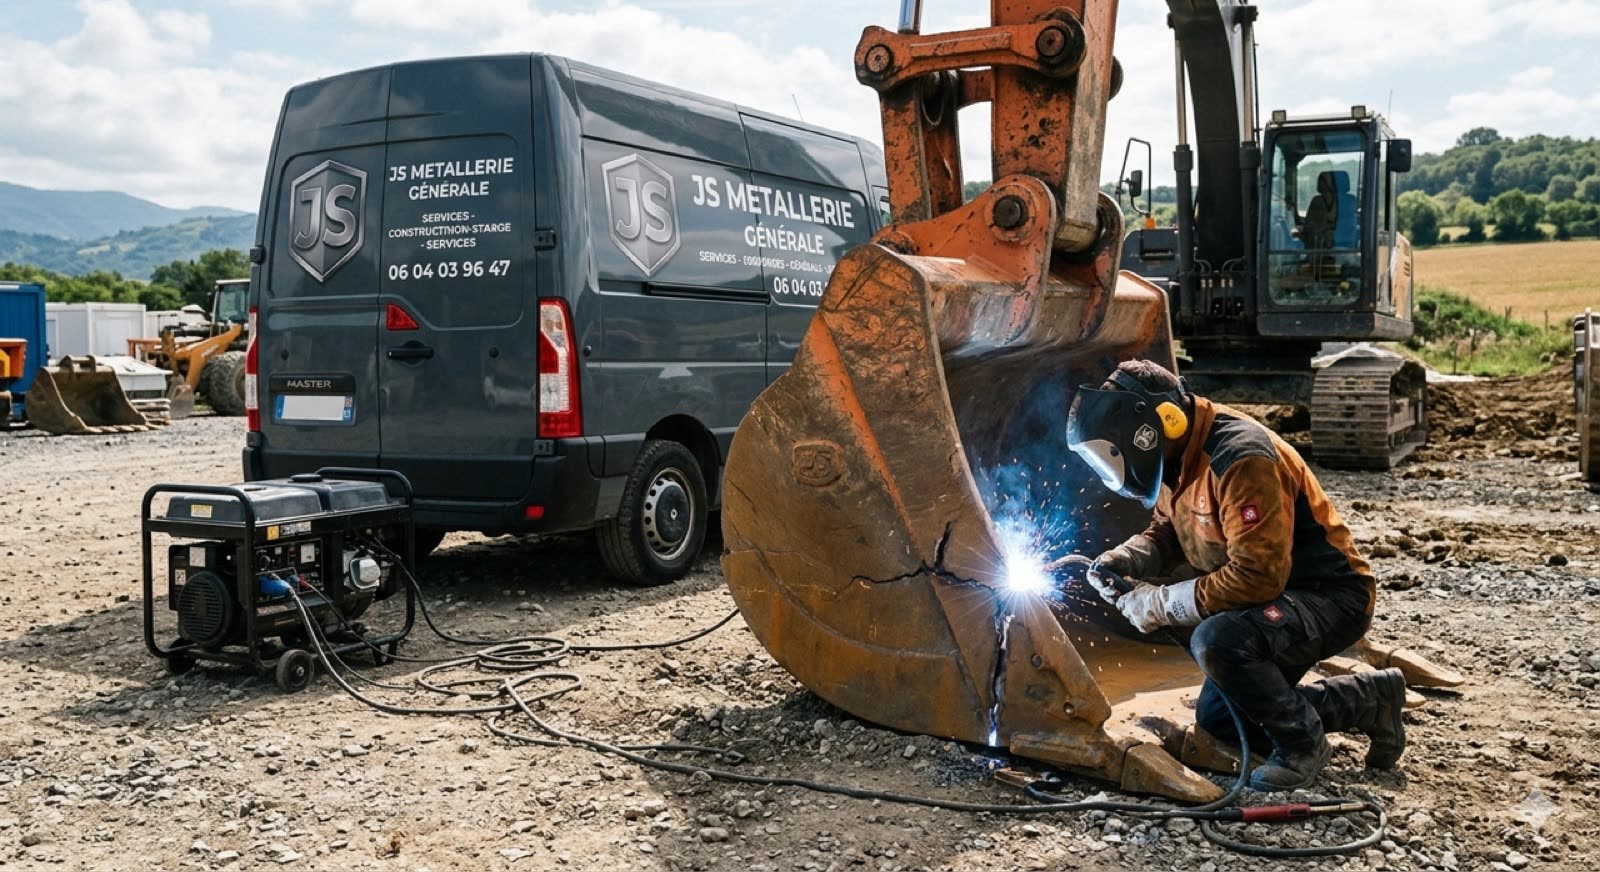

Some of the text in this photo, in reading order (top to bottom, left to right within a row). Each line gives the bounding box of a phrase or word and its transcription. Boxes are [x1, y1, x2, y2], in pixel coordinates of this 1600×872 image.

[389, 157, 514, 181] JS METALLERIE
[615, 176, 673, 243] JS
[691, 174, 855, 228] JS METALLERIE
[294, 184, 356, 249] JS
[422, 211, 470, 223] SERVICES
[426, 237, 476, 249] SERVICES
[744, 224, 825, 255] GÉNÉRALE
[388, 260, 511, 281] 06 04 03 96 47
[773, 276, 823, 297] 06 04 03
[286, 380, 332, 388] MASTER
